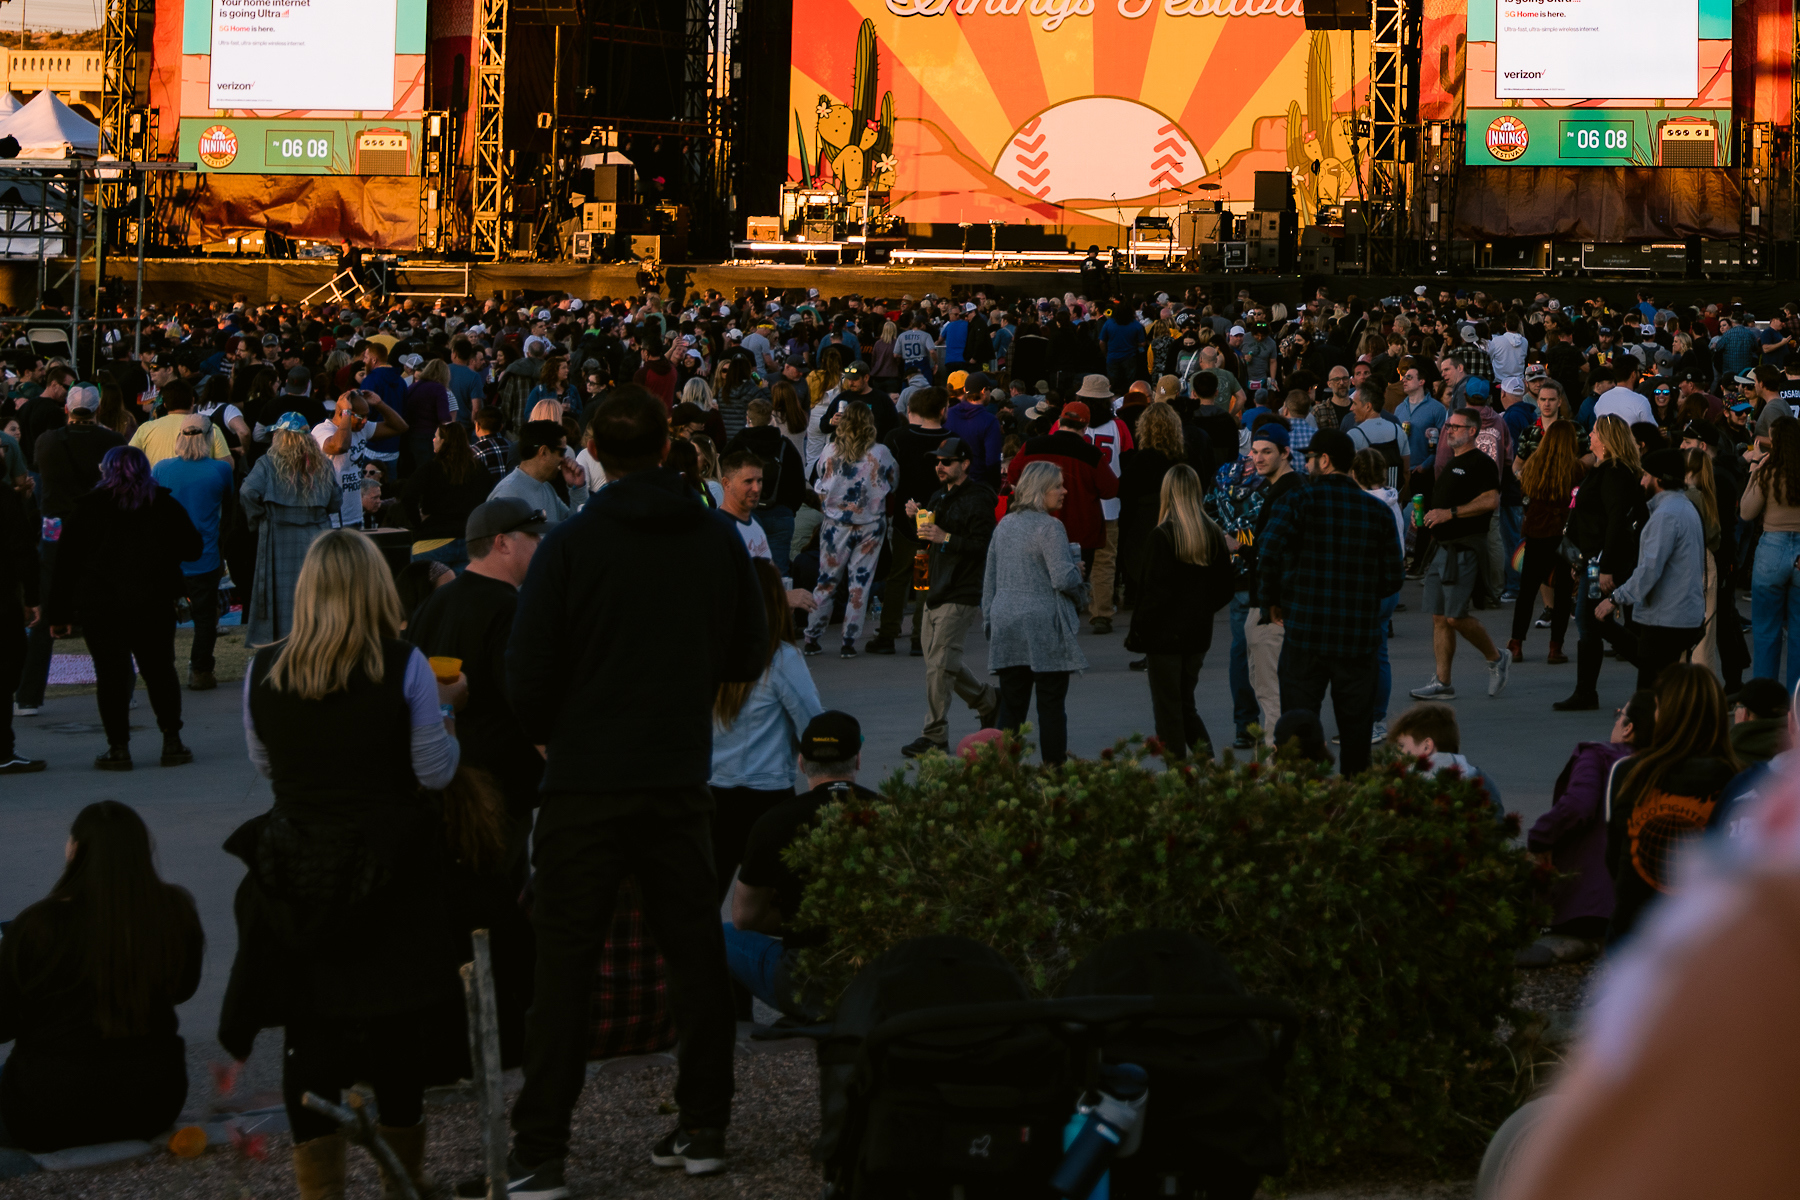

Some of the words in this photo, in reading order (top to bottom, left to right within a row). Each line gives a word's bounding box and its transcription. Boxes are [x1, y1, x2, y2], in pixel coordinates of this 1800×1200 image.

[219, 9, 228, 18] is
[229, 9, 256, 19] going
[257, 9, 281, 18] Ultra
[1504, 69, 1542, 79] verizon
[217, 81, 251, 90] verizon
[1488, 130, 1527, 147] INNINGS
[1577, 129, 1599, 149] 06
[1605, 129, 1627, 149] 08
[201, 138, 236, 155] INNINGS
[282, 138, 303, 158] 06
[307, 138, 328, 158] 08
[1491, 147, 1524, 159] FESTIVAL
[202, 155, 234, 166] FESTIVAL
[904, 342, 921, 357] 50
[342, 472, 358, 483] FREE
